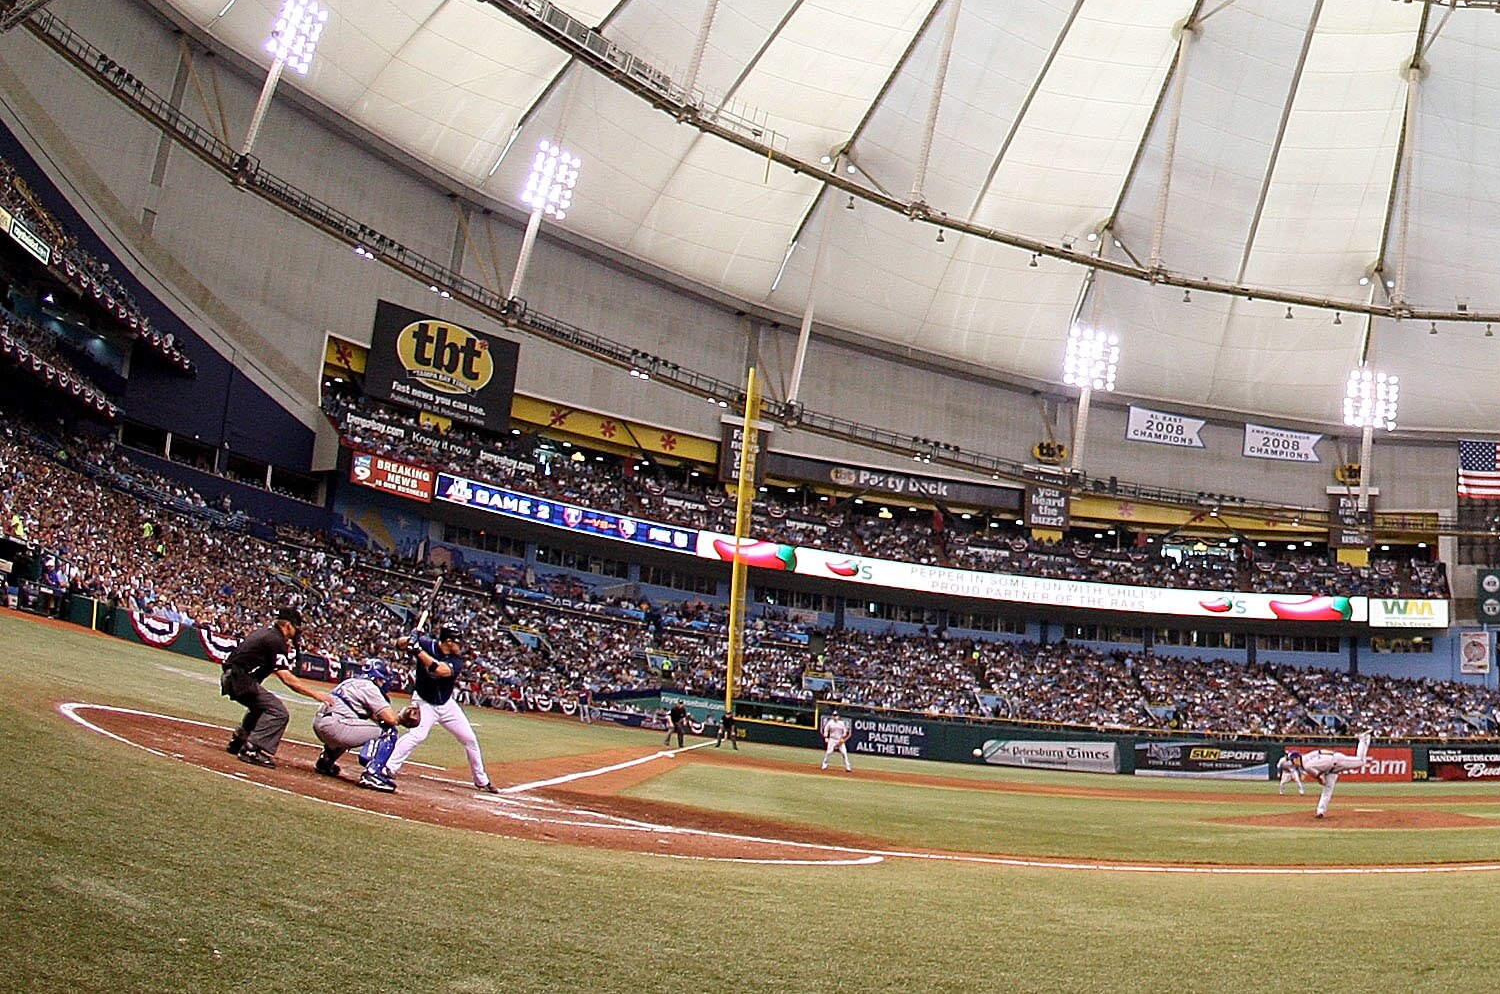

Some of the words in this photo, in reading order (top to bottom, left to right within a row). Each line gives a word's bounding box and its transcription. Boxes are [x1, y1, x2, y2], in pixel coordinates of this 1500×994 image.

[412, 322, 482, 381] tbt
[392, 381, 411, 395] Fast
[411, 386, 434, 401] news
[434, 394, 451, 407] you
[452, 398, 468, 410] can
[468, 404, 486, 417] use.
[1150, 413, 1162, 422] AL
[1163, 414, 1183, 424] EAST
[1145, 419, 1185, 436] 2008
[1251, 428, 1288, 438] AMERICAN
[1288, 432, 1311, 441] LEAGUE
[412, 430, 441, 449] Know
[441, 439, 449, 450] it
[1132, 428, 1193, 446] CHAMPIONS
[1261, 436, 1300, 451] 2008
[1248, 445, 1309, 461] CHAMPIONS
[353, 466, 372, 481] 9
[387, 472, 418, 489] NEWS
[376, 459, 430, 482] BREAKING
[1031, 495, 1065, 508] heard
[1038, 487, 1060, 500] you
[475, 488, 531, 515] GAME
[536, 504, 550, 519] 2
[1038, 505, 1058, 517] the
[1031, 514, 1064, 527] buzz?
[910, 566, 965, 582] PEPPER
[969, 574, 985, 584] IN
[989, 575, 1029, 589] SOME
[1033, 580, 1062, 592] FUN
[1067, 583, 1102, 595] WITH
[931, 581, 980, 597] PROUD
[985, 586, 1051, 603] PARTNER
[1055, 593, 1073, 604] OF
[1079, 596, 1105, 607] THE
[1110, 598, 1146, 610] RAYS
[1382, 599, 1436, 616] WM
[661, 696, 725, 711] raysaseball.com
[854, 720, 876, 732] OUR
[877, 722, 925, 737] NATIONAL
[868, 732, 910, 745] PASTIME
[856, 741, 876, 753] ALL
[876, 743, 896, 755] THE
[896, 744, 920, 757] TIME
[1012, 745, 1064, 760] Petersburg
[1066, 747, 1110, 761] Times
[1189, 748, 1220, 760] SUN
[1219, 749, 1265, 761] SPORTS
[1362, 755, 1407, 775] Farm
